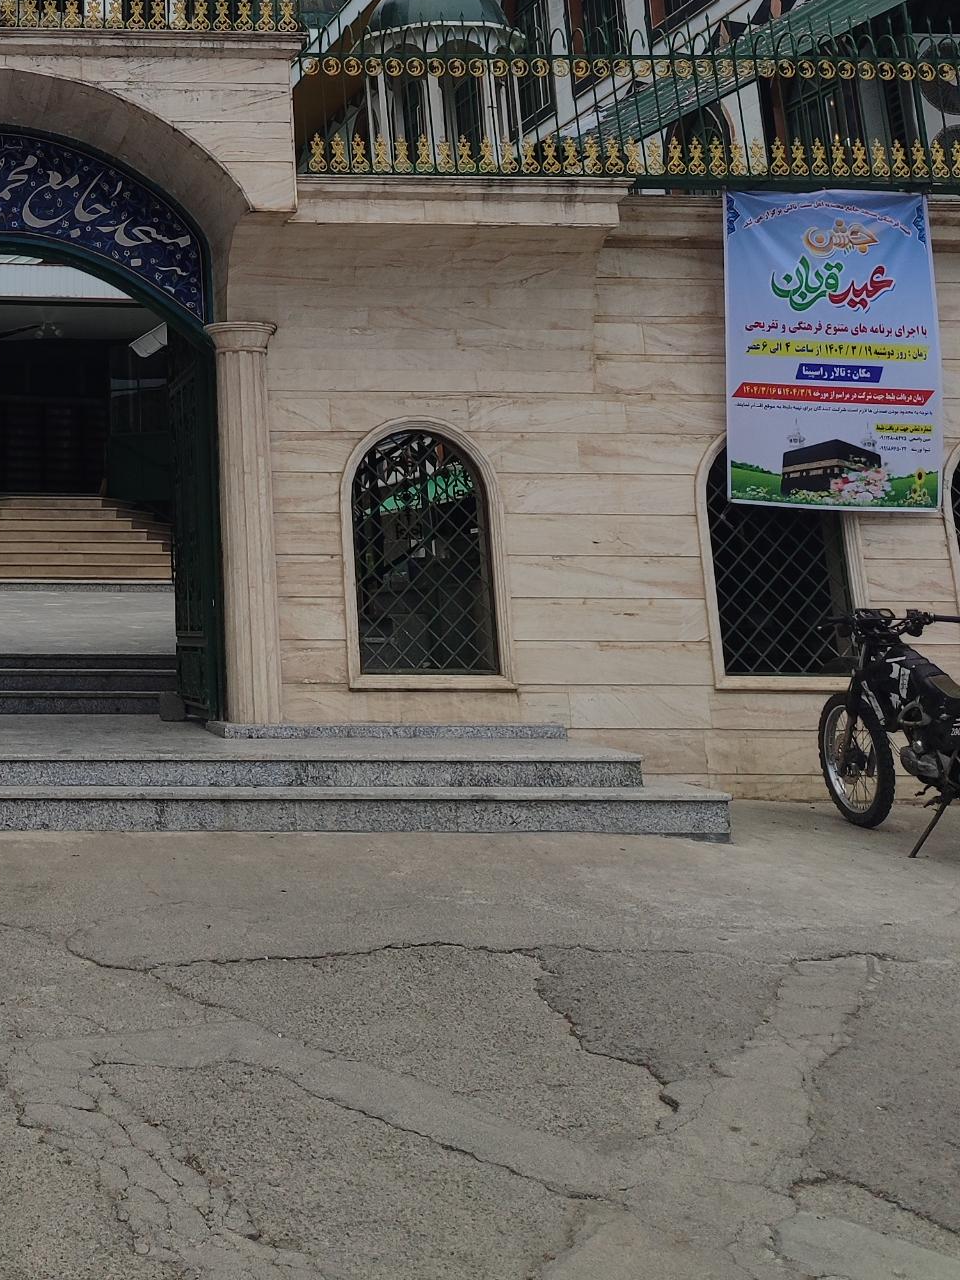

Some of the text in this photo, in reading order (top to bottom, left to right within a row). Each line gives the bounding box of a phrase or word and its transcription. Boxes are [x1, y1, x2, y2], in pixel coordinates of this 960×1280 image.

[22, 170, 112, 238] جامع
[96, 217, 190, 267] مسجد
[803, 219, 880, 257] جشن
[771, 256, 895, 311] عید قربان
[745, 319, 779, 332] تفریحی
[789, 320, 823, 335] فرهنگی
[825, 322, 849, 336] متنوع
[895, 324, 920, 339] اجرای
[746, 343, 761, 353] عصر
[770, 342, 782, 354] الی
[794, 343, 814, 353] ساعت
[874, 347, 895, 360] دوشنبه
[802, 366, 828, 379] راسپینا
[830, 367, 846, 379] تالار
[835, 391, 850, 400] مراسم
[857, 392, 872, 401] شرکت
[913, 394, 925, 403] زمان
